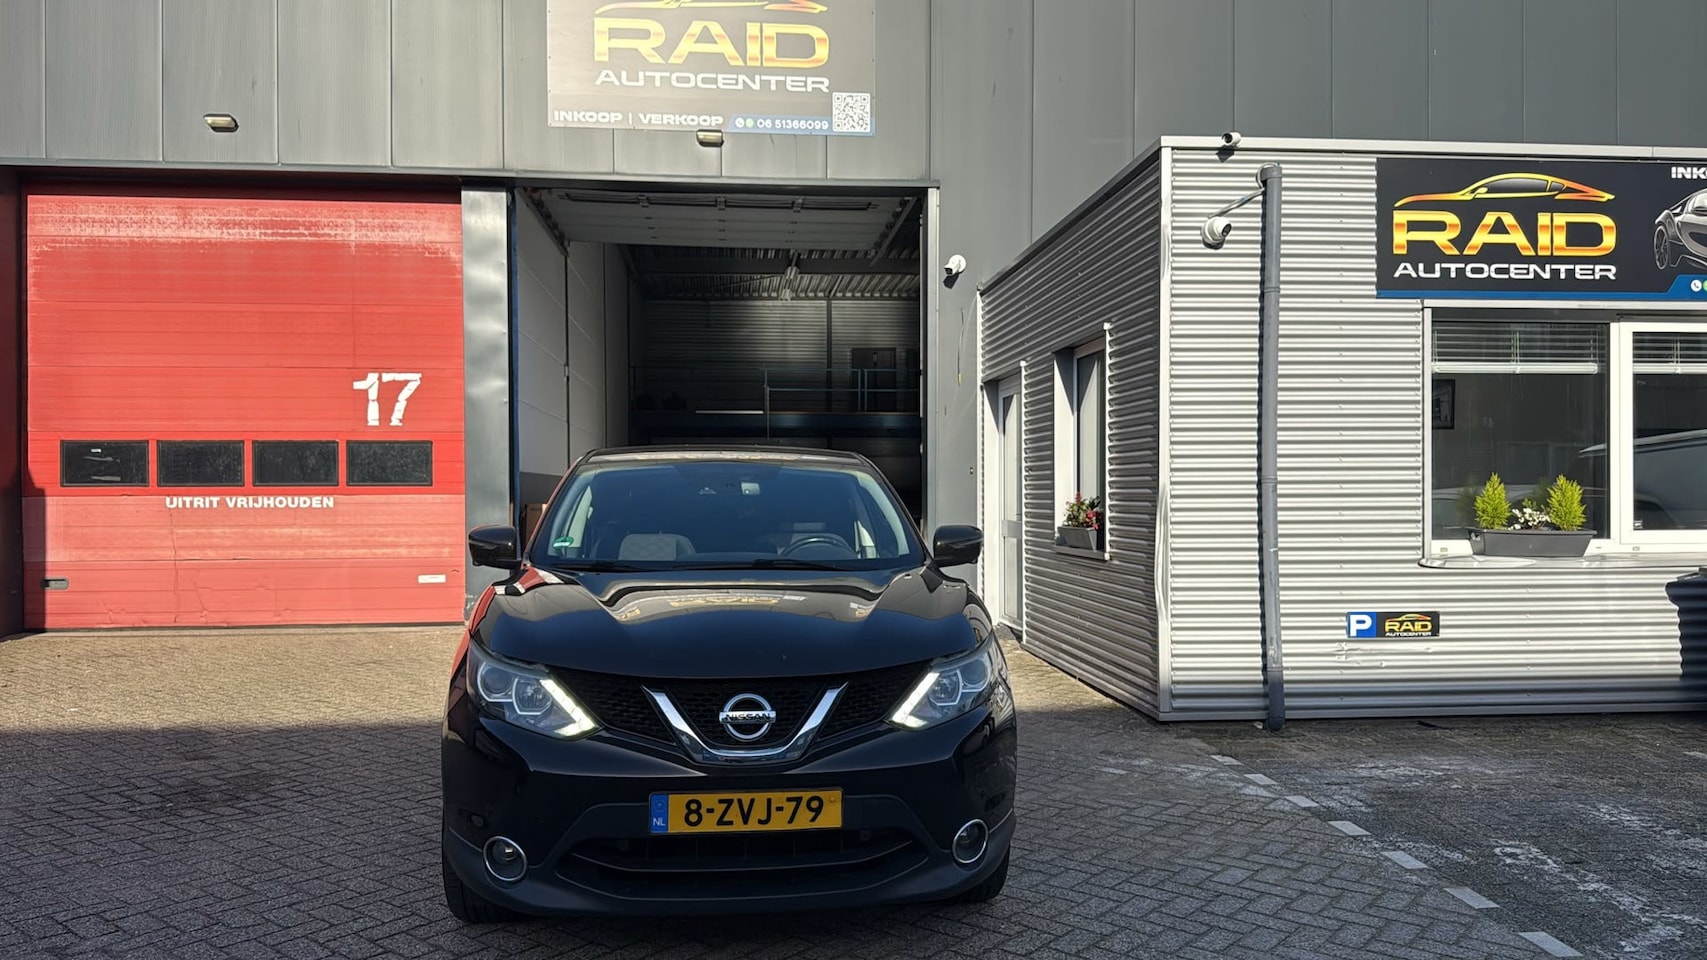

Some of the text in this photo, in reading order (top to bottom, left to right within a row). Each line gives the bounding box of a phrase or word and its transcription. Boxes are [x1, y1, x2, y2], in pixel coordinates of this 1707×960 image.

[594, 17, 829, 68] RAID
[595, 69, 829, 93] AUTOCENTER
[554, 110, 724, 127] INKOOP VERKOOP
[757, 119, 829, 129] 06 51366099
[1671, 166, 1707, 179] INK
[1393, 210, 1617, 257] RAID
[1393, 262, 1617, 280] AUTOCENTER
[353, 372, 422, 426] 17
[165, 496, 335, 509] UITRIT VRIJHOUDEN
[1350, 614, 1372, 637] P
[1385, 621, 1432, 632] RAID
[725, 712, 772, 722] NISSAN
[684, 795, 824, 827] 8-ZVJ-79
[652, 818, 666, 827] NL
